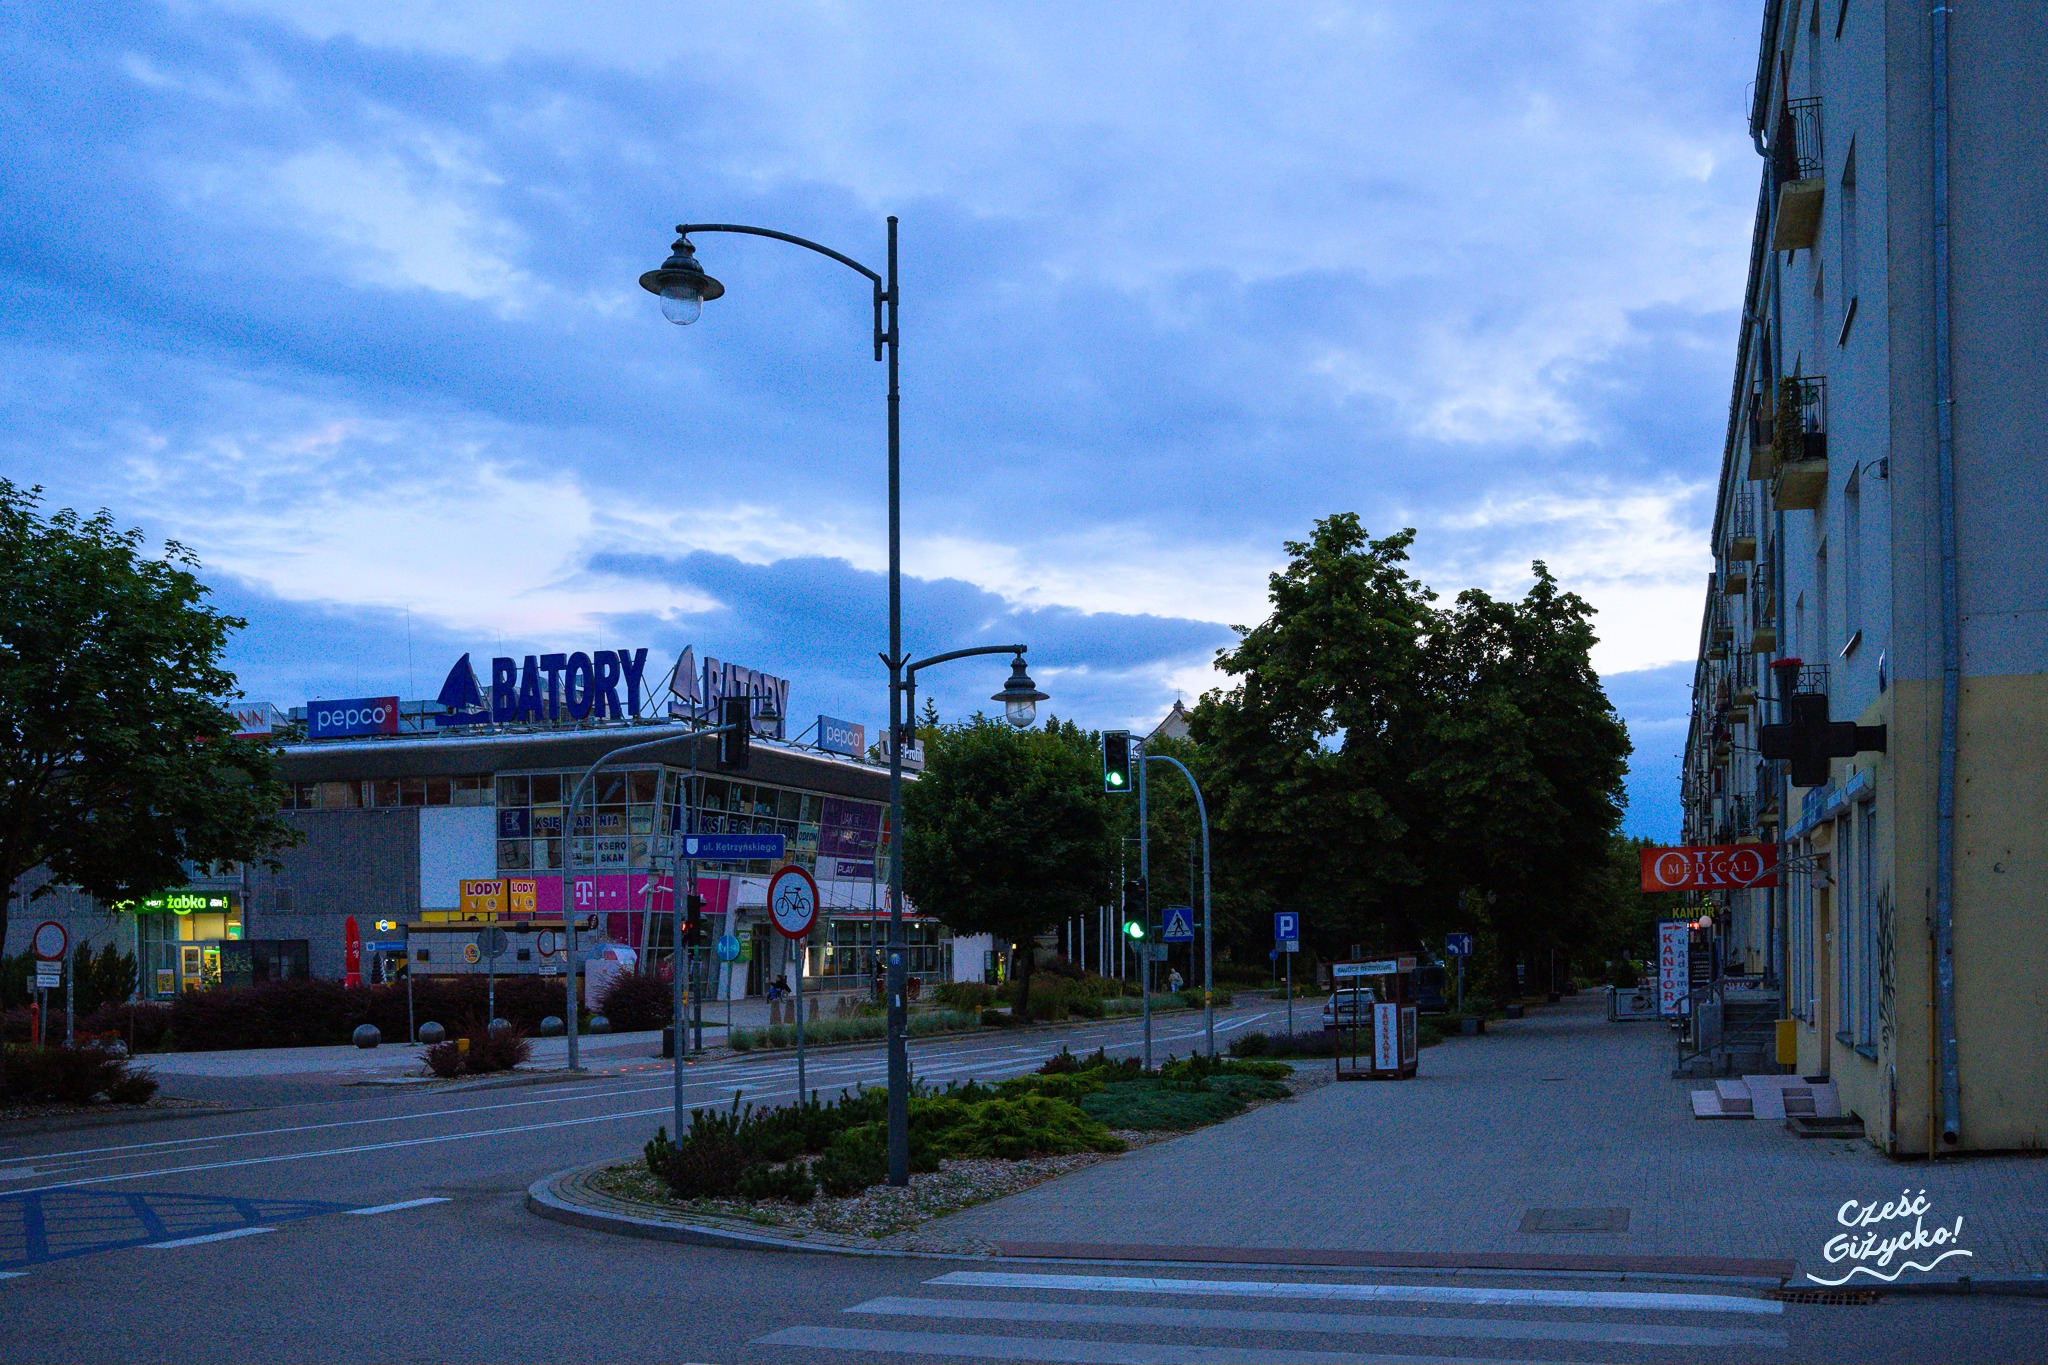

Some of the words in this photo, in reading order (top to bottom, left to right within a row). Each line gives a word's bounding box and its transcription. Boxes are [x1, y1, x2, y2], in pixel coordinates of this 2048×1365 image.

[492, 647, 648, 722] BATORY
[826, 723, 860, 748] pepco
[598, 841, 627, 851] KSERO
[703, 842, 714, 851] ul.
[715, 842, 777, 853] Kętrzyńskiego
[601, 853, 624, 863] SKAN
[837, 864, 855, 874] PLAY
[1654, 849, 1764, 887] OKO
[1668, 861, 1751, 875] MEDICAL
[466, 882, 502, 896] LODY
[512, 882, 534, 893] LODY
[167, 895, 206, 909] żabka
[1672, 906, 1716, 919] KANTOR
[1281, 916, 1293, 937] P
[1662, 934, 1675, 1001] KANTOR
[1382, 1006, 1390, 1067] TRUSKAWKI
